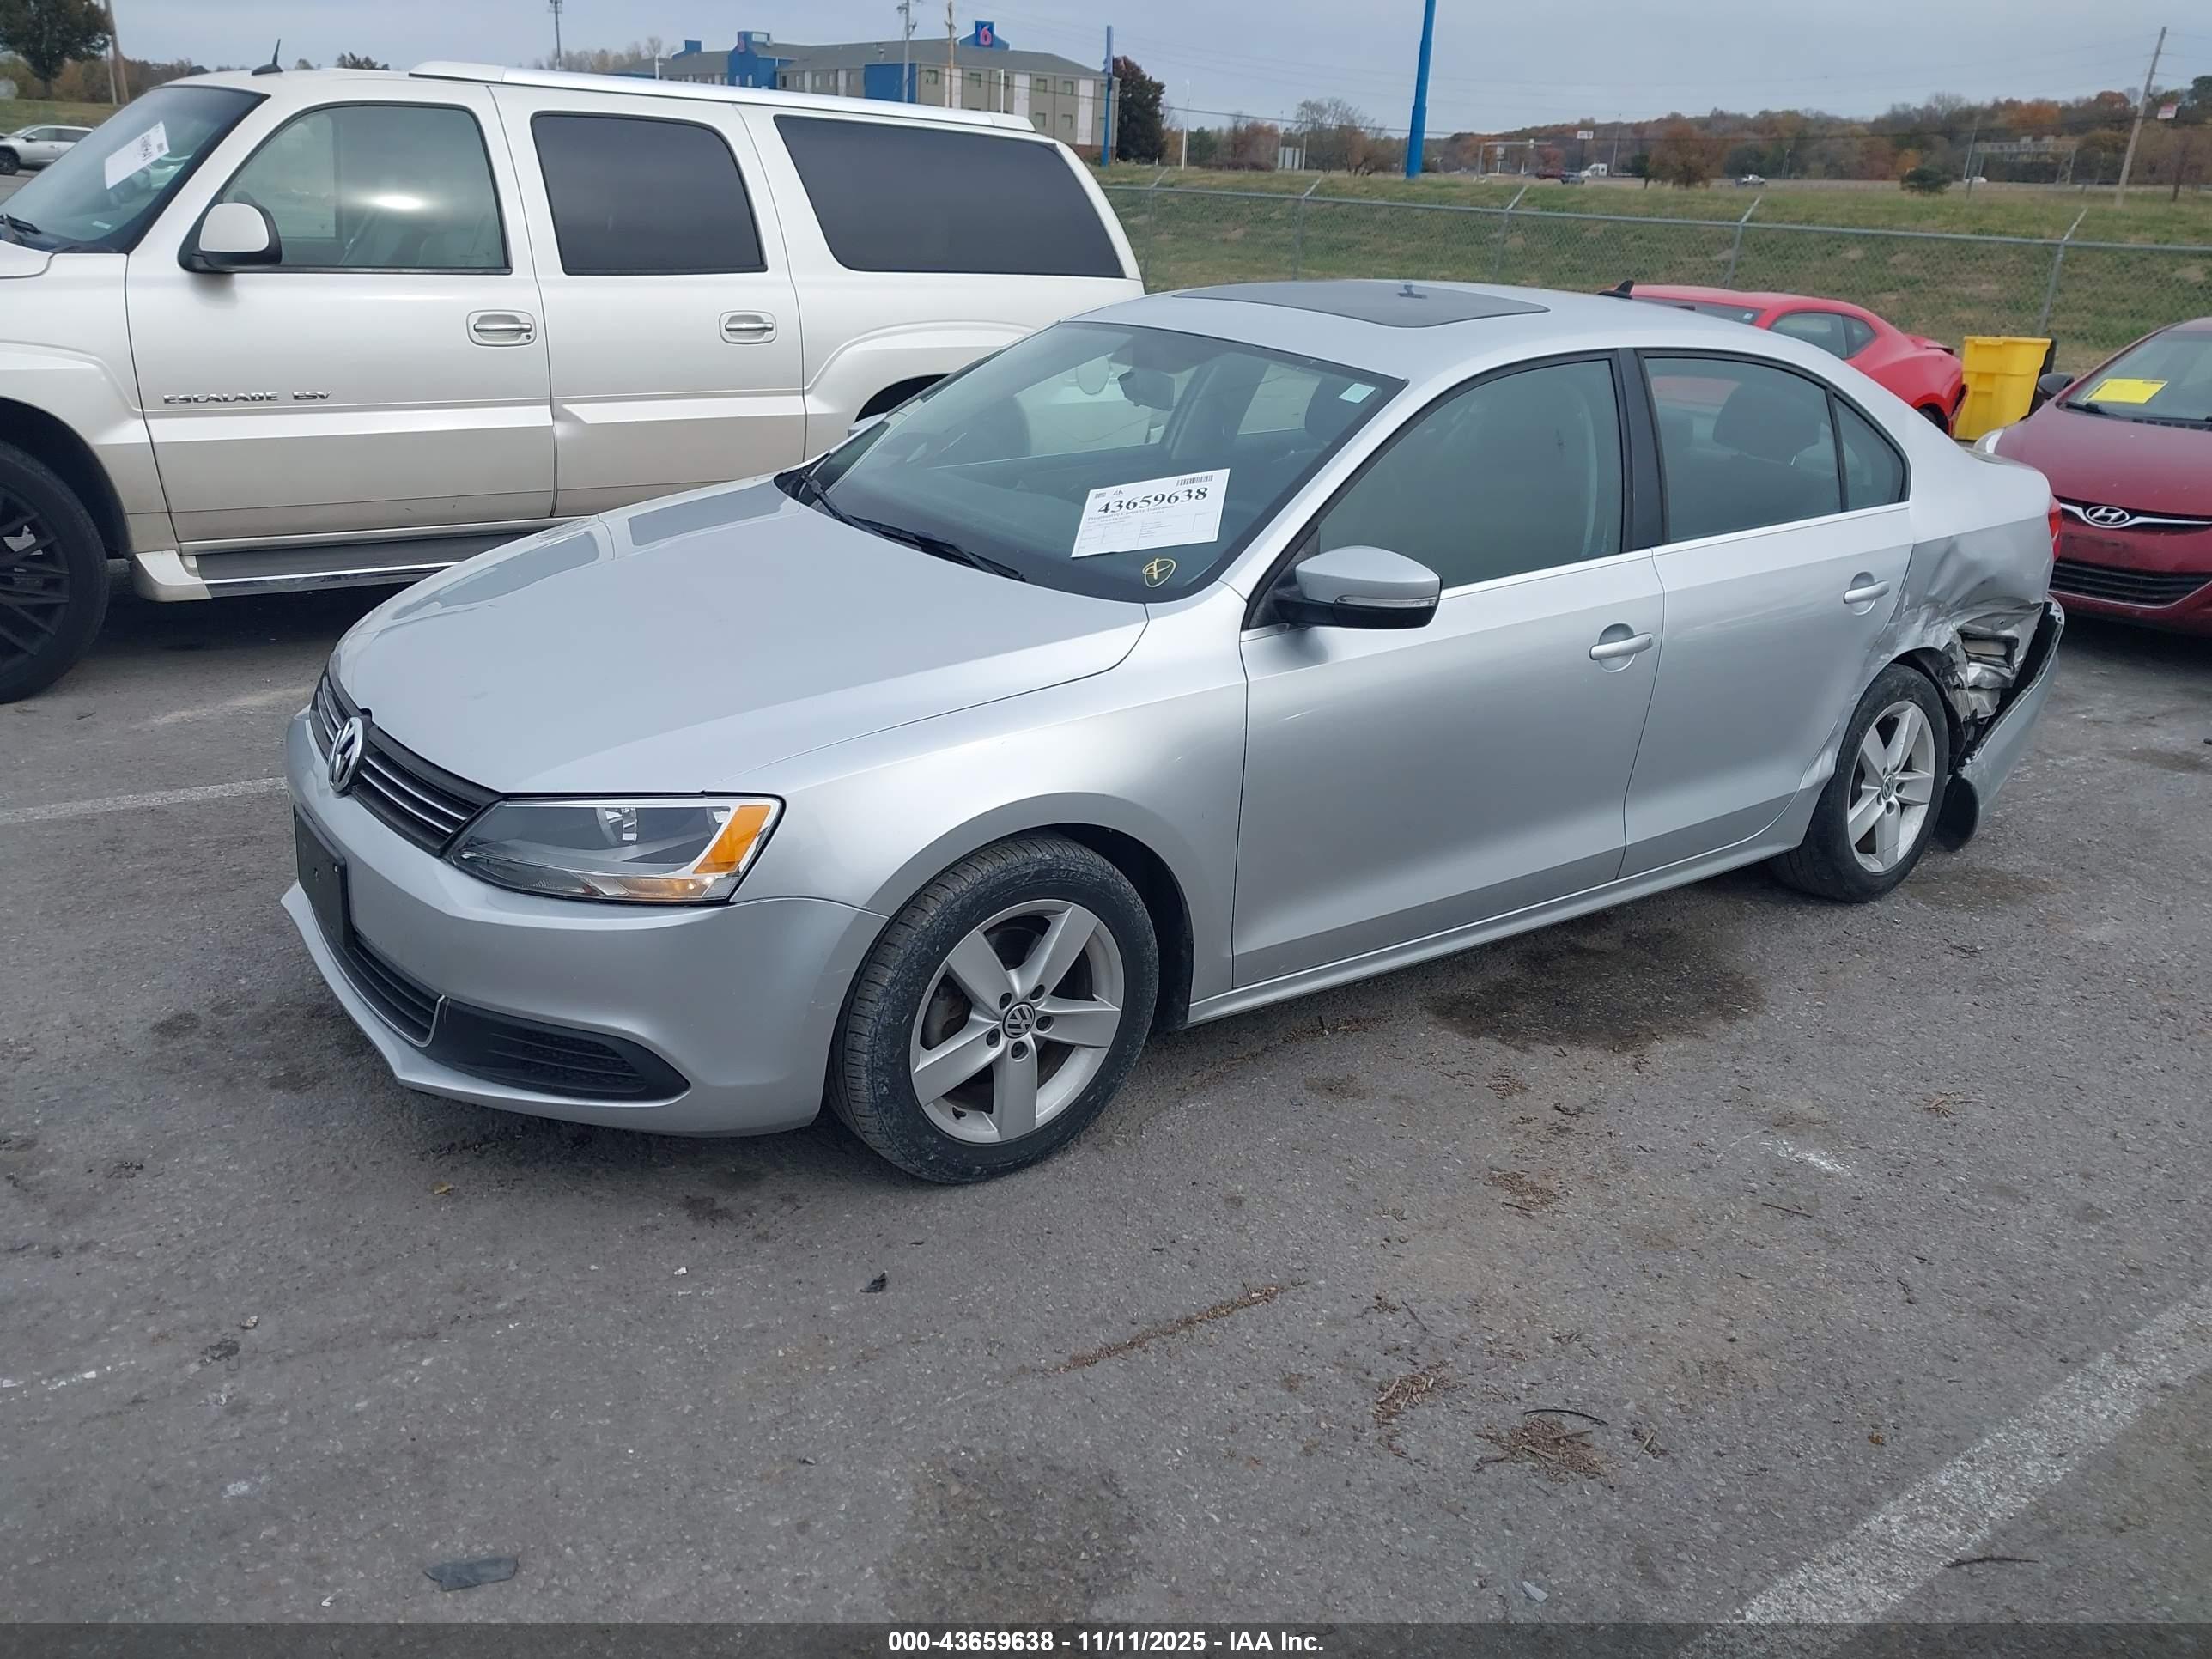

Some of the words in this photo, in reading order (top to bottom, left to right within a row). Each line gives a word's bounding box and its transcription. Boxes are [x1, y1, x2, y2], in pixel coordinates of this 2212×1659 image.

[980, 25, 992, 46] 6
[162, 392, 279, 404] ESCALADE
[292, 390, 332, 401] ESV
[1097, 487, 1209, 514] 43659638
